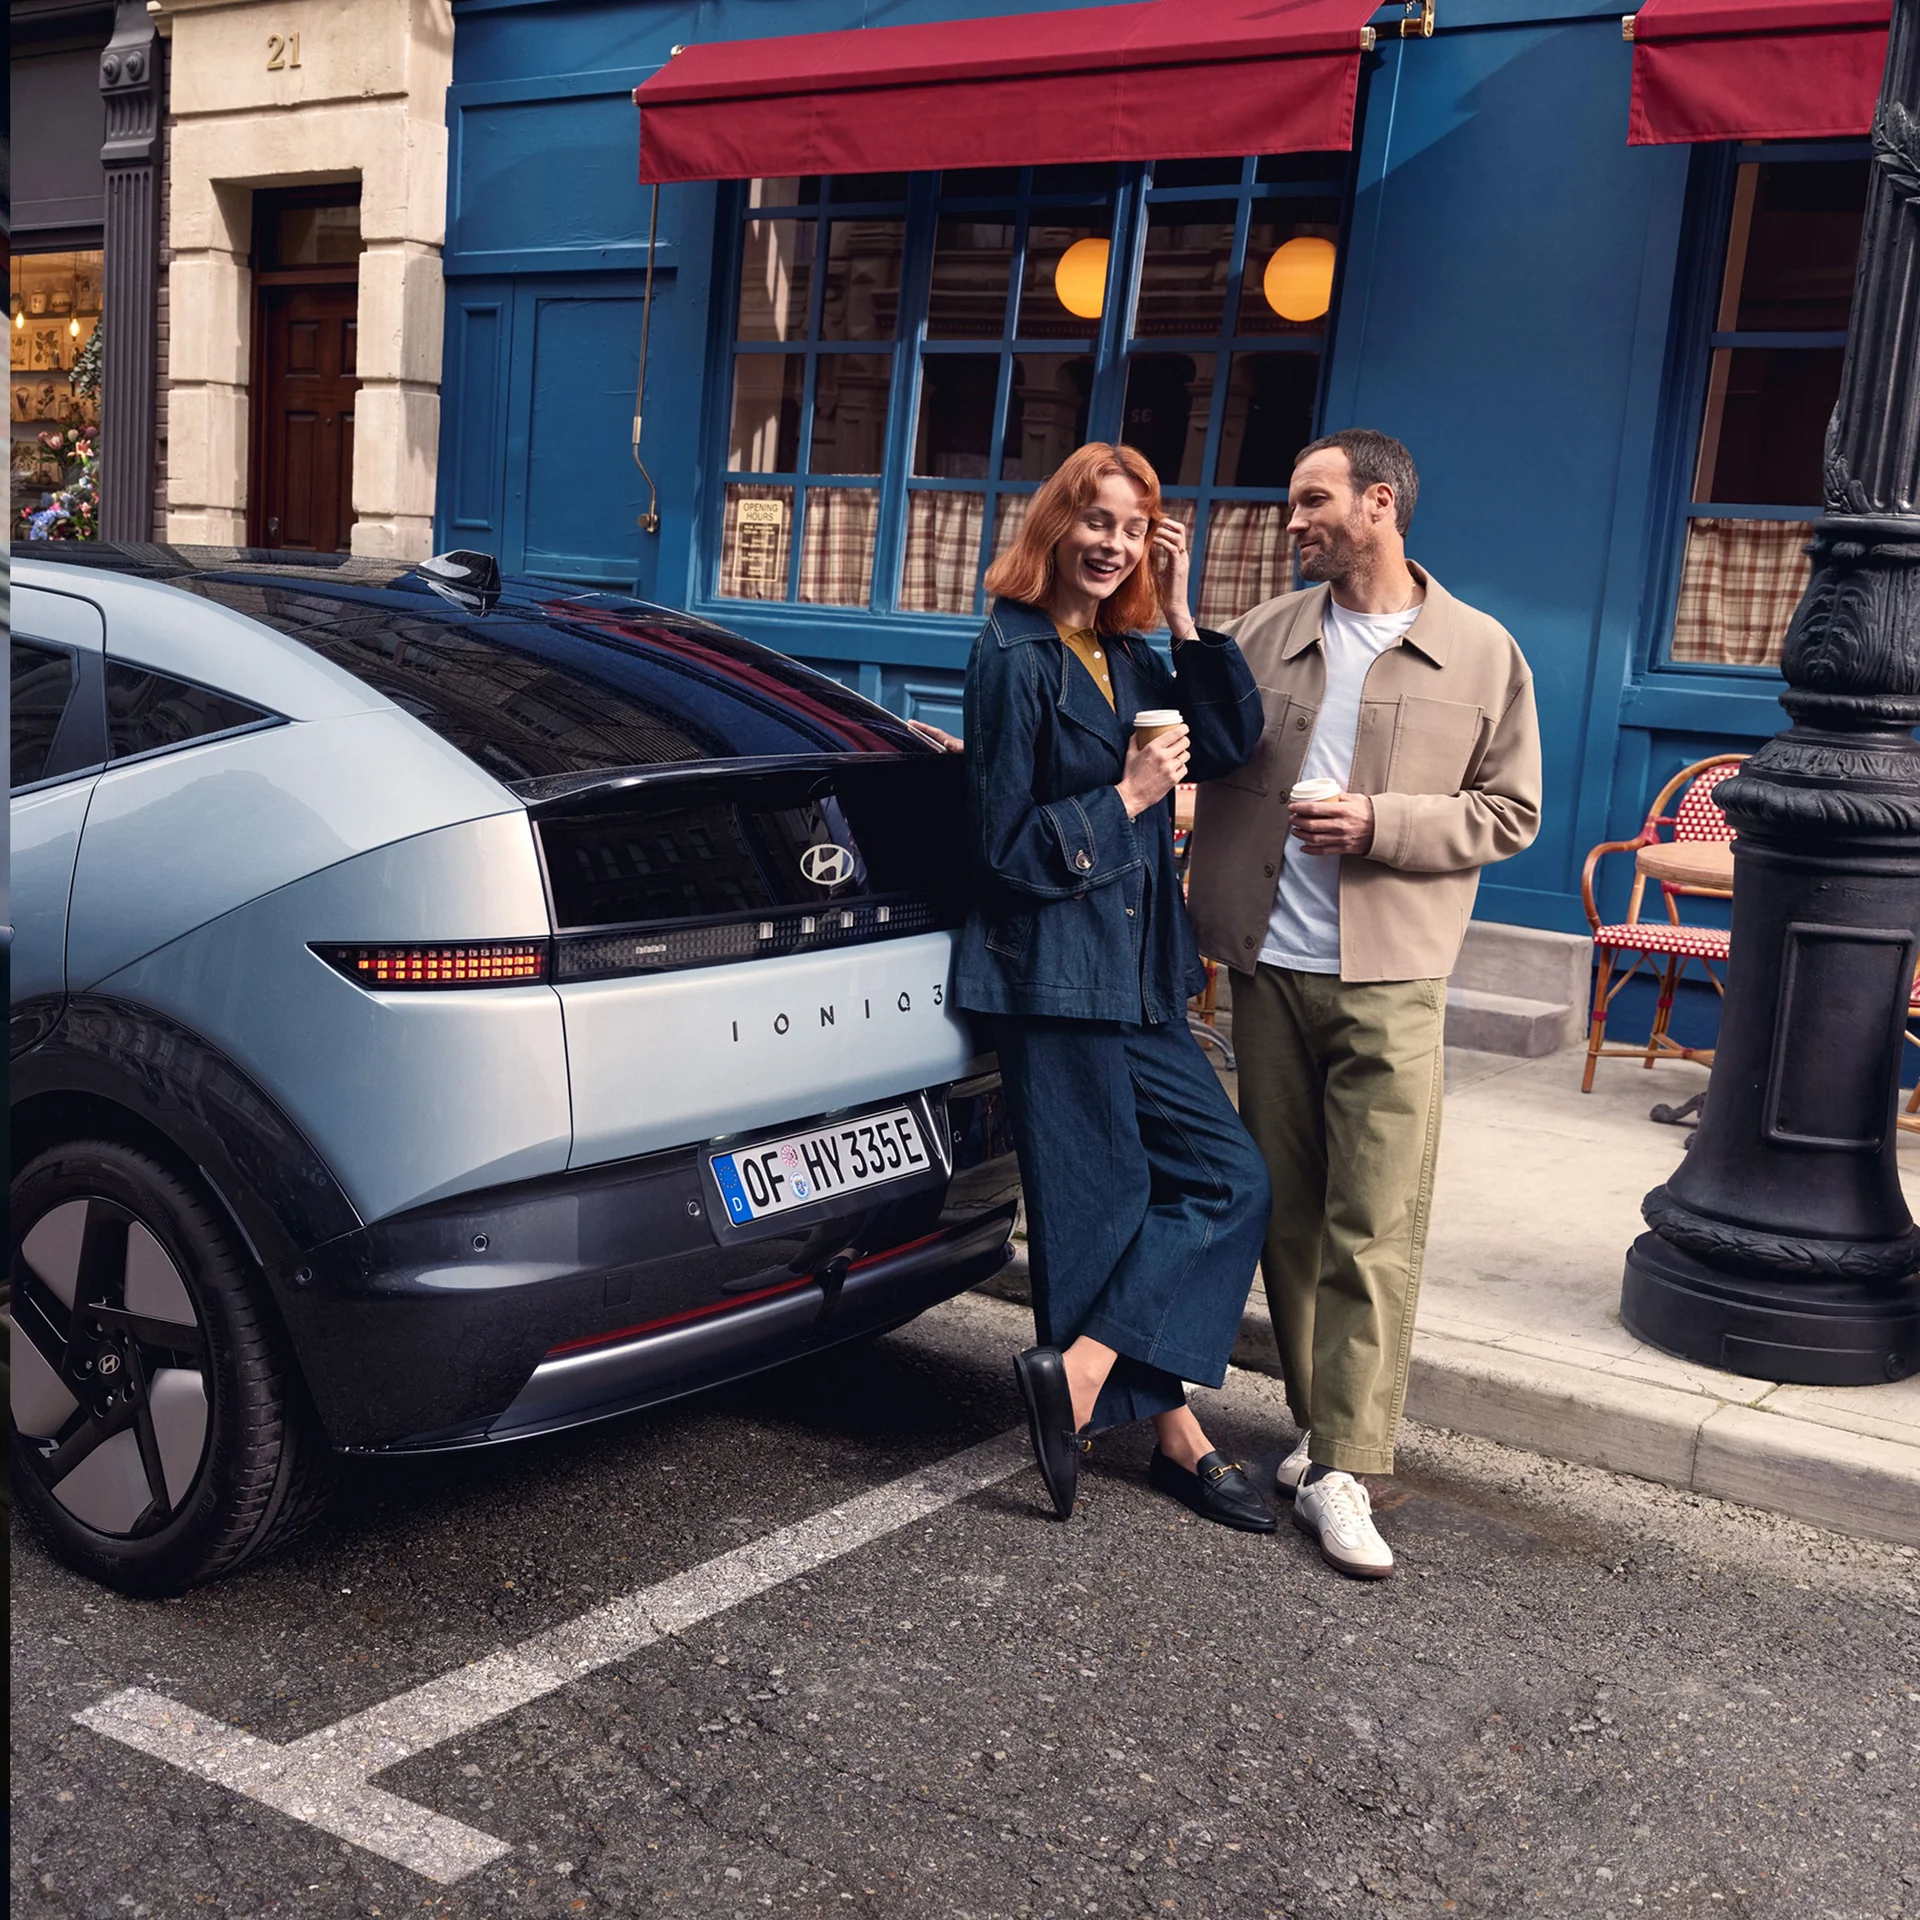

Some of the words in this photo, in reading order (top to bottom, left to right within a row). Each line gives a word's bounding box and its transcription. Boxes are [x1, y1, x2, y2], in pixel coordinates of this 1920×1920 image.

[267, 32, 302, 71] 21
[743, 502, 779, 513] OPENING
[746, 512, 774, 521] HOURS
[732, 991, 911, 1042] IONIQ
[932, 984, 944, 1005] 3
[742, 1151, 785, 1208] OF
[731, 1197, 743, 1212] D
